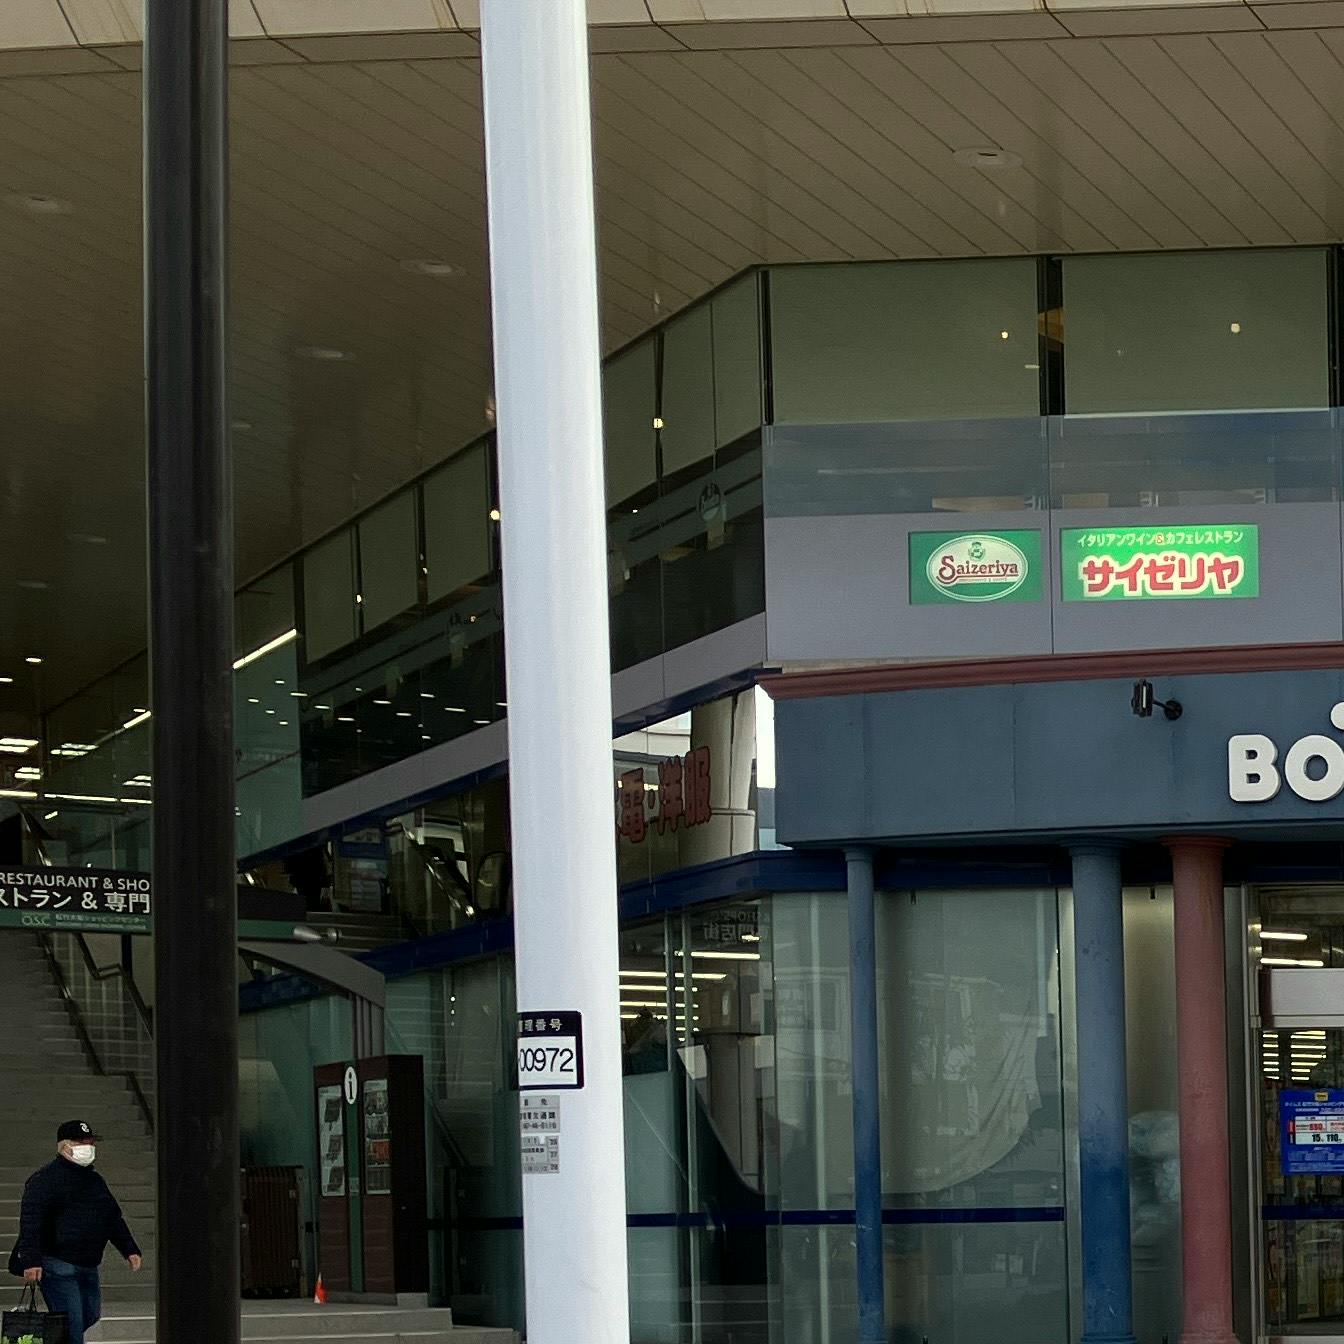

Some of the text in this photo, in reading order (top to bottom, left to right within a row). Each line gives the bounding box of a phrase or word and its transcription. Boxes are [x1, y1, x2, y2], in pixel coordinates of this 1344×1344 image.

[936, 555, 1018, 584] Saizeriya
[1082, 556, 1239, 592] サイゼリヤ
